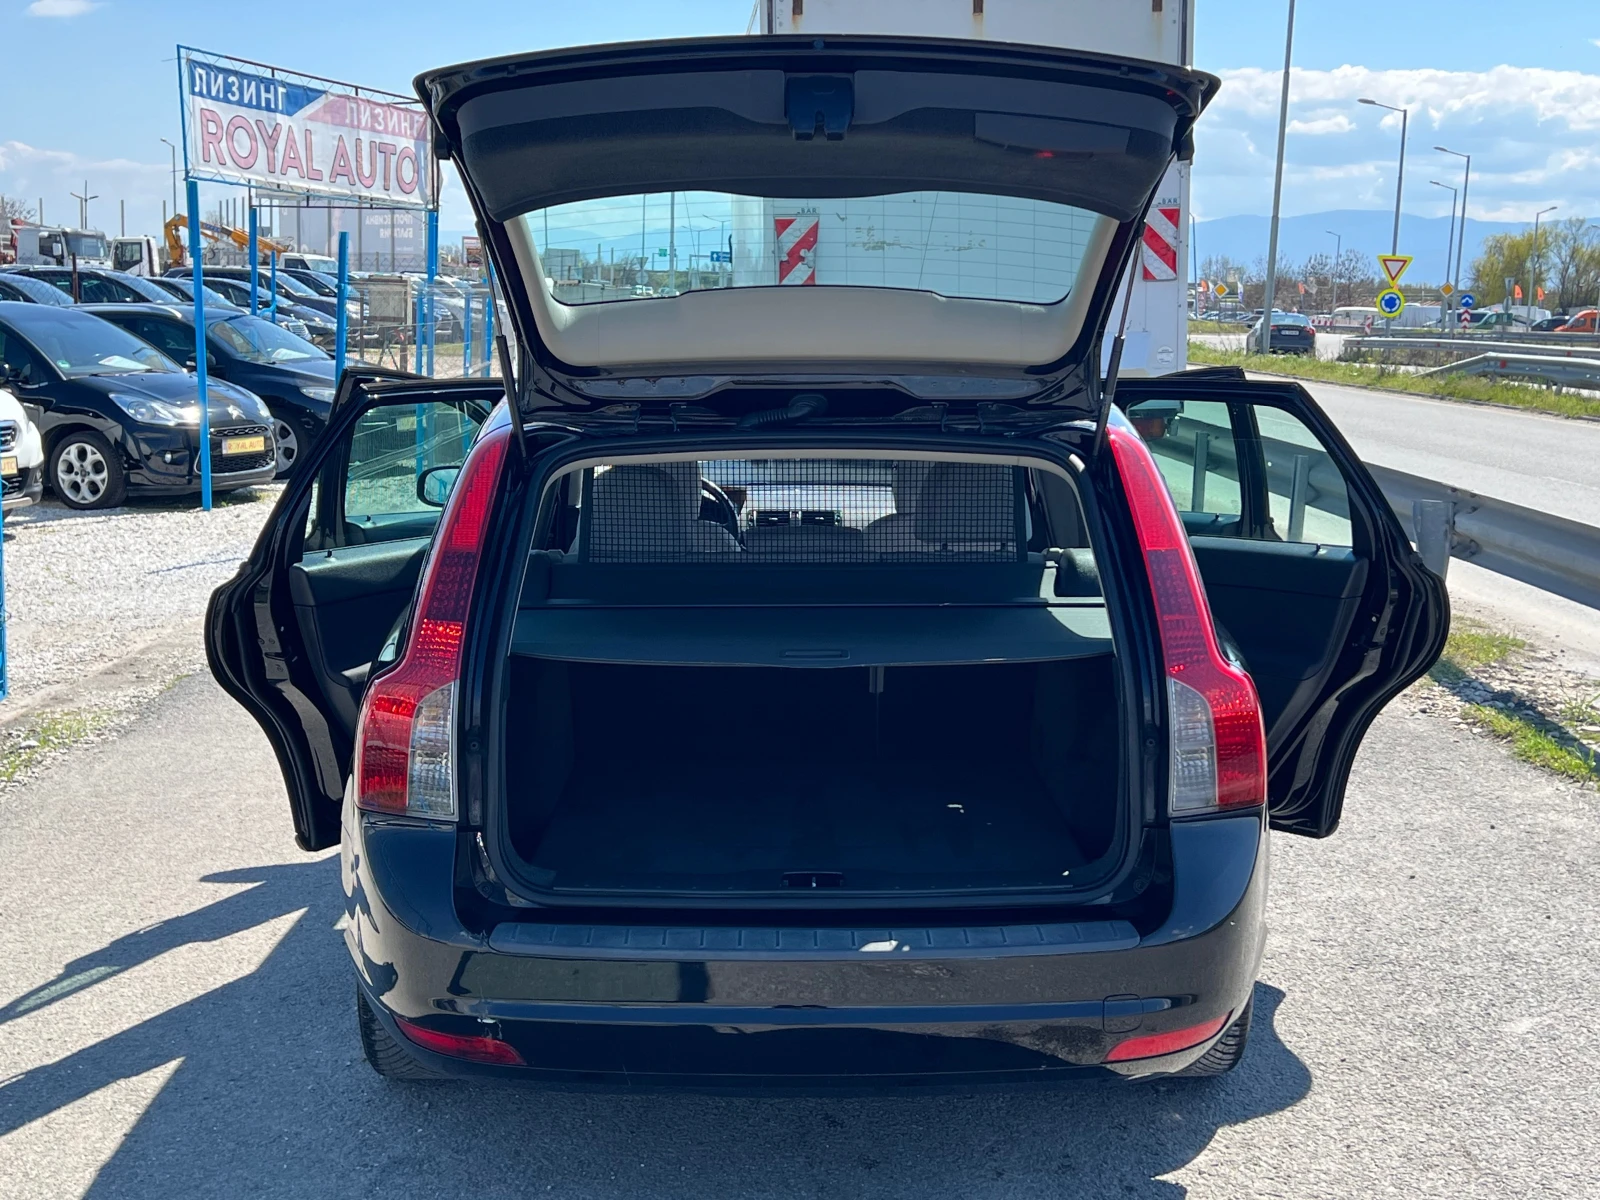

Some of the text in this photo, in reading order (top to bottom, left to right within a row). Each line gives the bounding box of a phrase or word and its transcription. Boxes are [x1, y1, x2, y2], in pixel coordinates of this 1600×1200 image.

[194, 67, 287, 110] ЛИЗИНГ
[345, 101, 424, 137] ЛИЗИНГ
[200, 107, 419, 194] ROYAL AUTO
